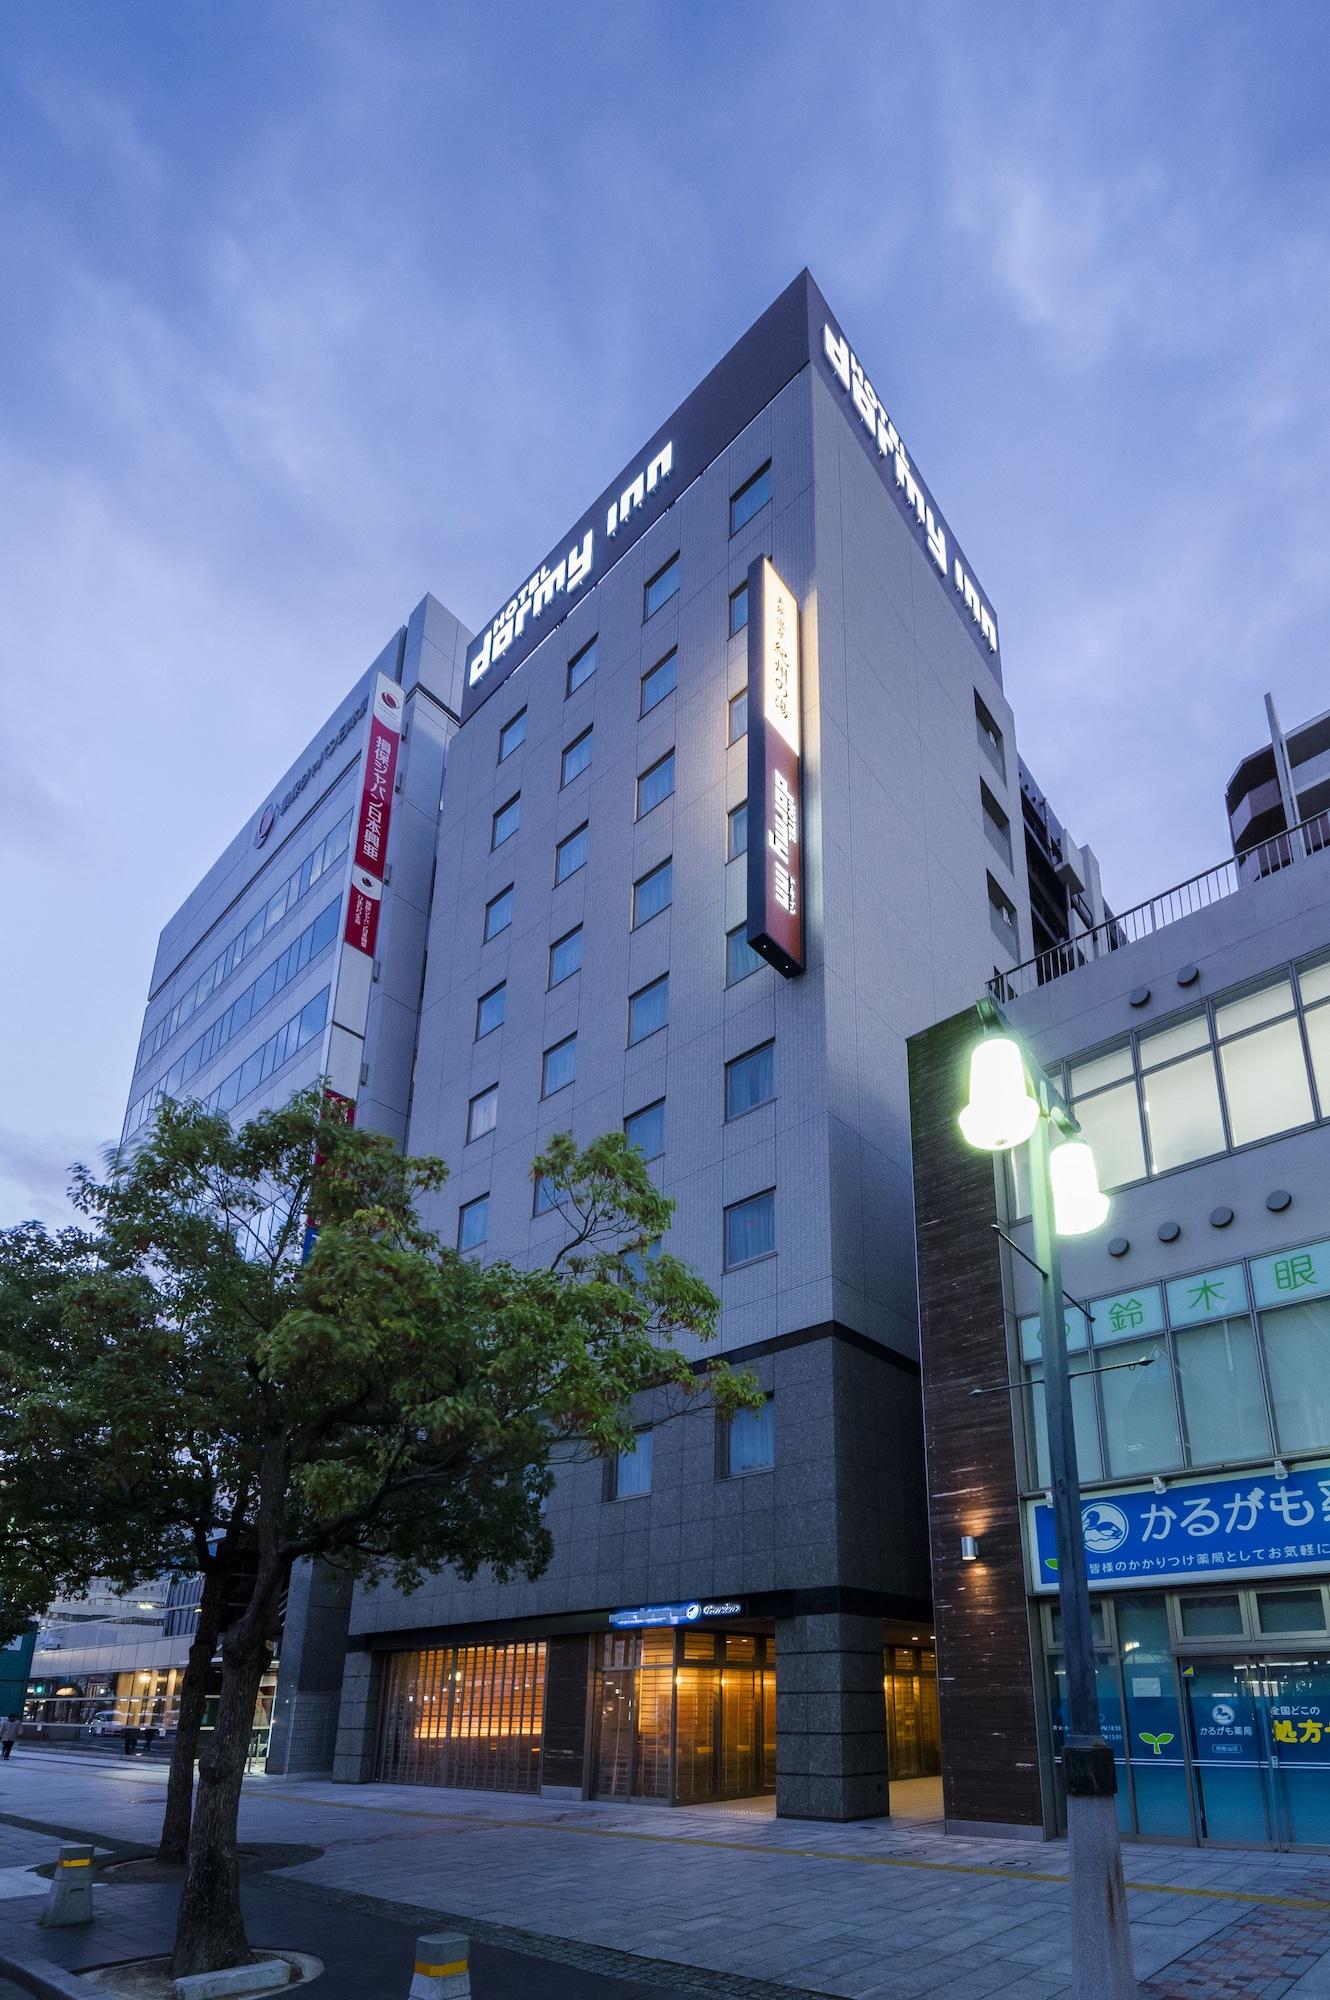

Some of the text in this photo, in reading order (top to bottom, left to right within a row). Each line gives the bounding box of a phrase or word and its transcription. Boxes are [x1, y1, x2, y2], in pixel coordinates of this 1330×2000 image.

[823, 322, 998, 652] dormy inn
[468, 440, 674, 687] dormy inn
[493, 564, 551, 636] HOTEL
[768, 768, 796, 865] dormy
[1199, 1725, 1254, 1737] かるがも薬局
[1270, 1705, 1321, 1717] 全国どこの
[1272, 1718, 1330, 1743] 処方
